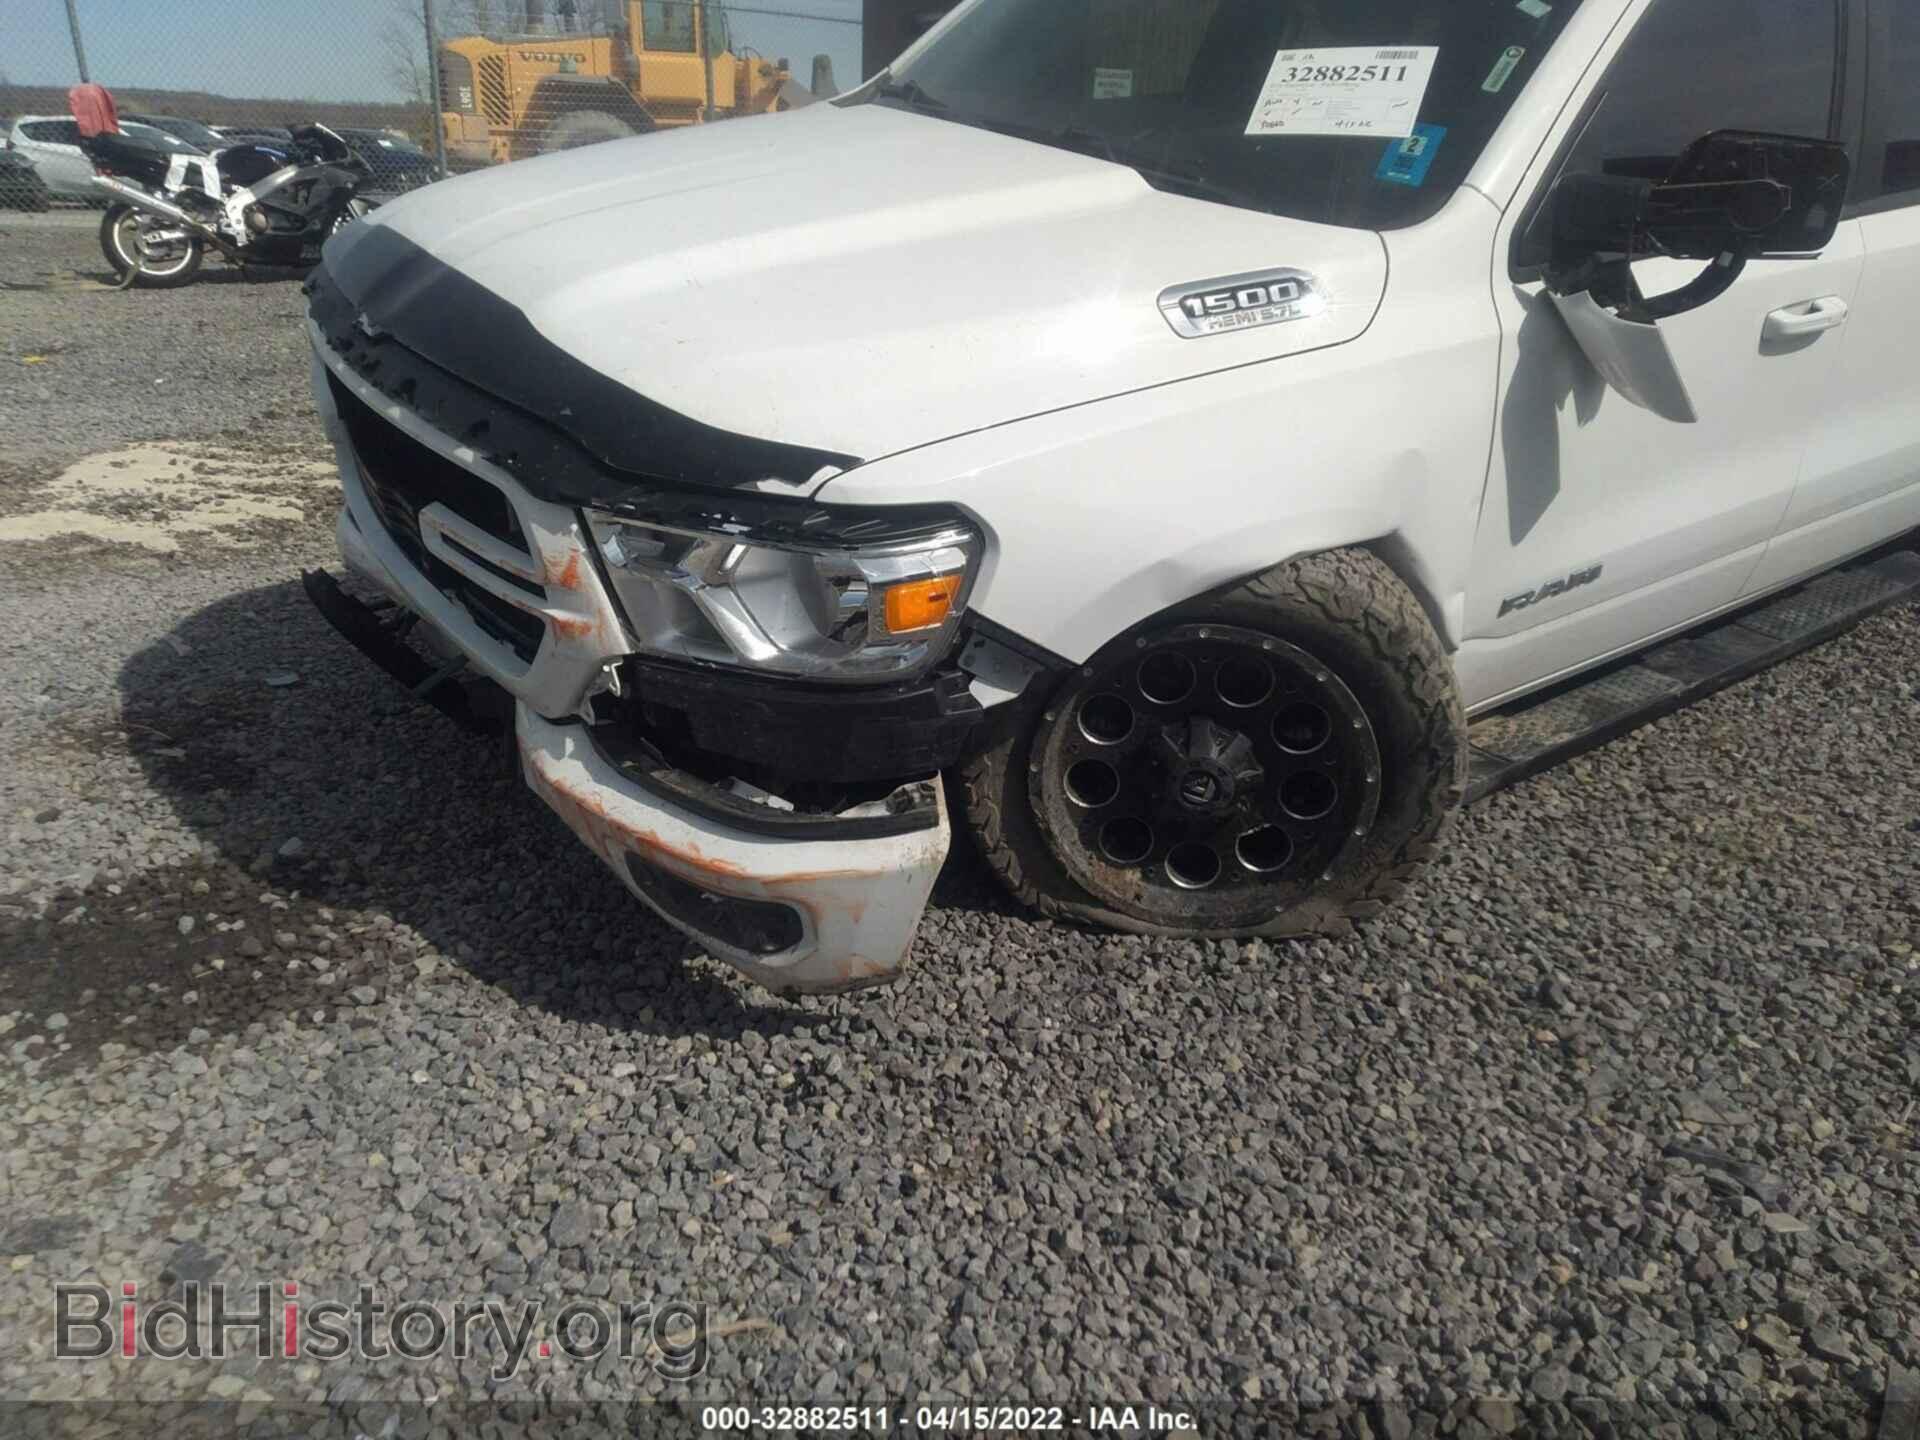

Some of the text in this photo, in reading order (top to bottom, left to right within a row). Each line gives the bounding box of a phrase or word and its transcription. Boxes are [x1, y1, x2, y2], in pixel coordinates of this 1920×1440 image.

[518, 50, 586, 63] VOLVO
[1281, 65, 1407, 83] 32882511
[1406, 137, 1420, 153] 2
[1184, 281, 1300, 316] 1500
[1207, 303, 1302, 330] HEMI 5.7L
[1496, 564, 1603, 619] RAM
